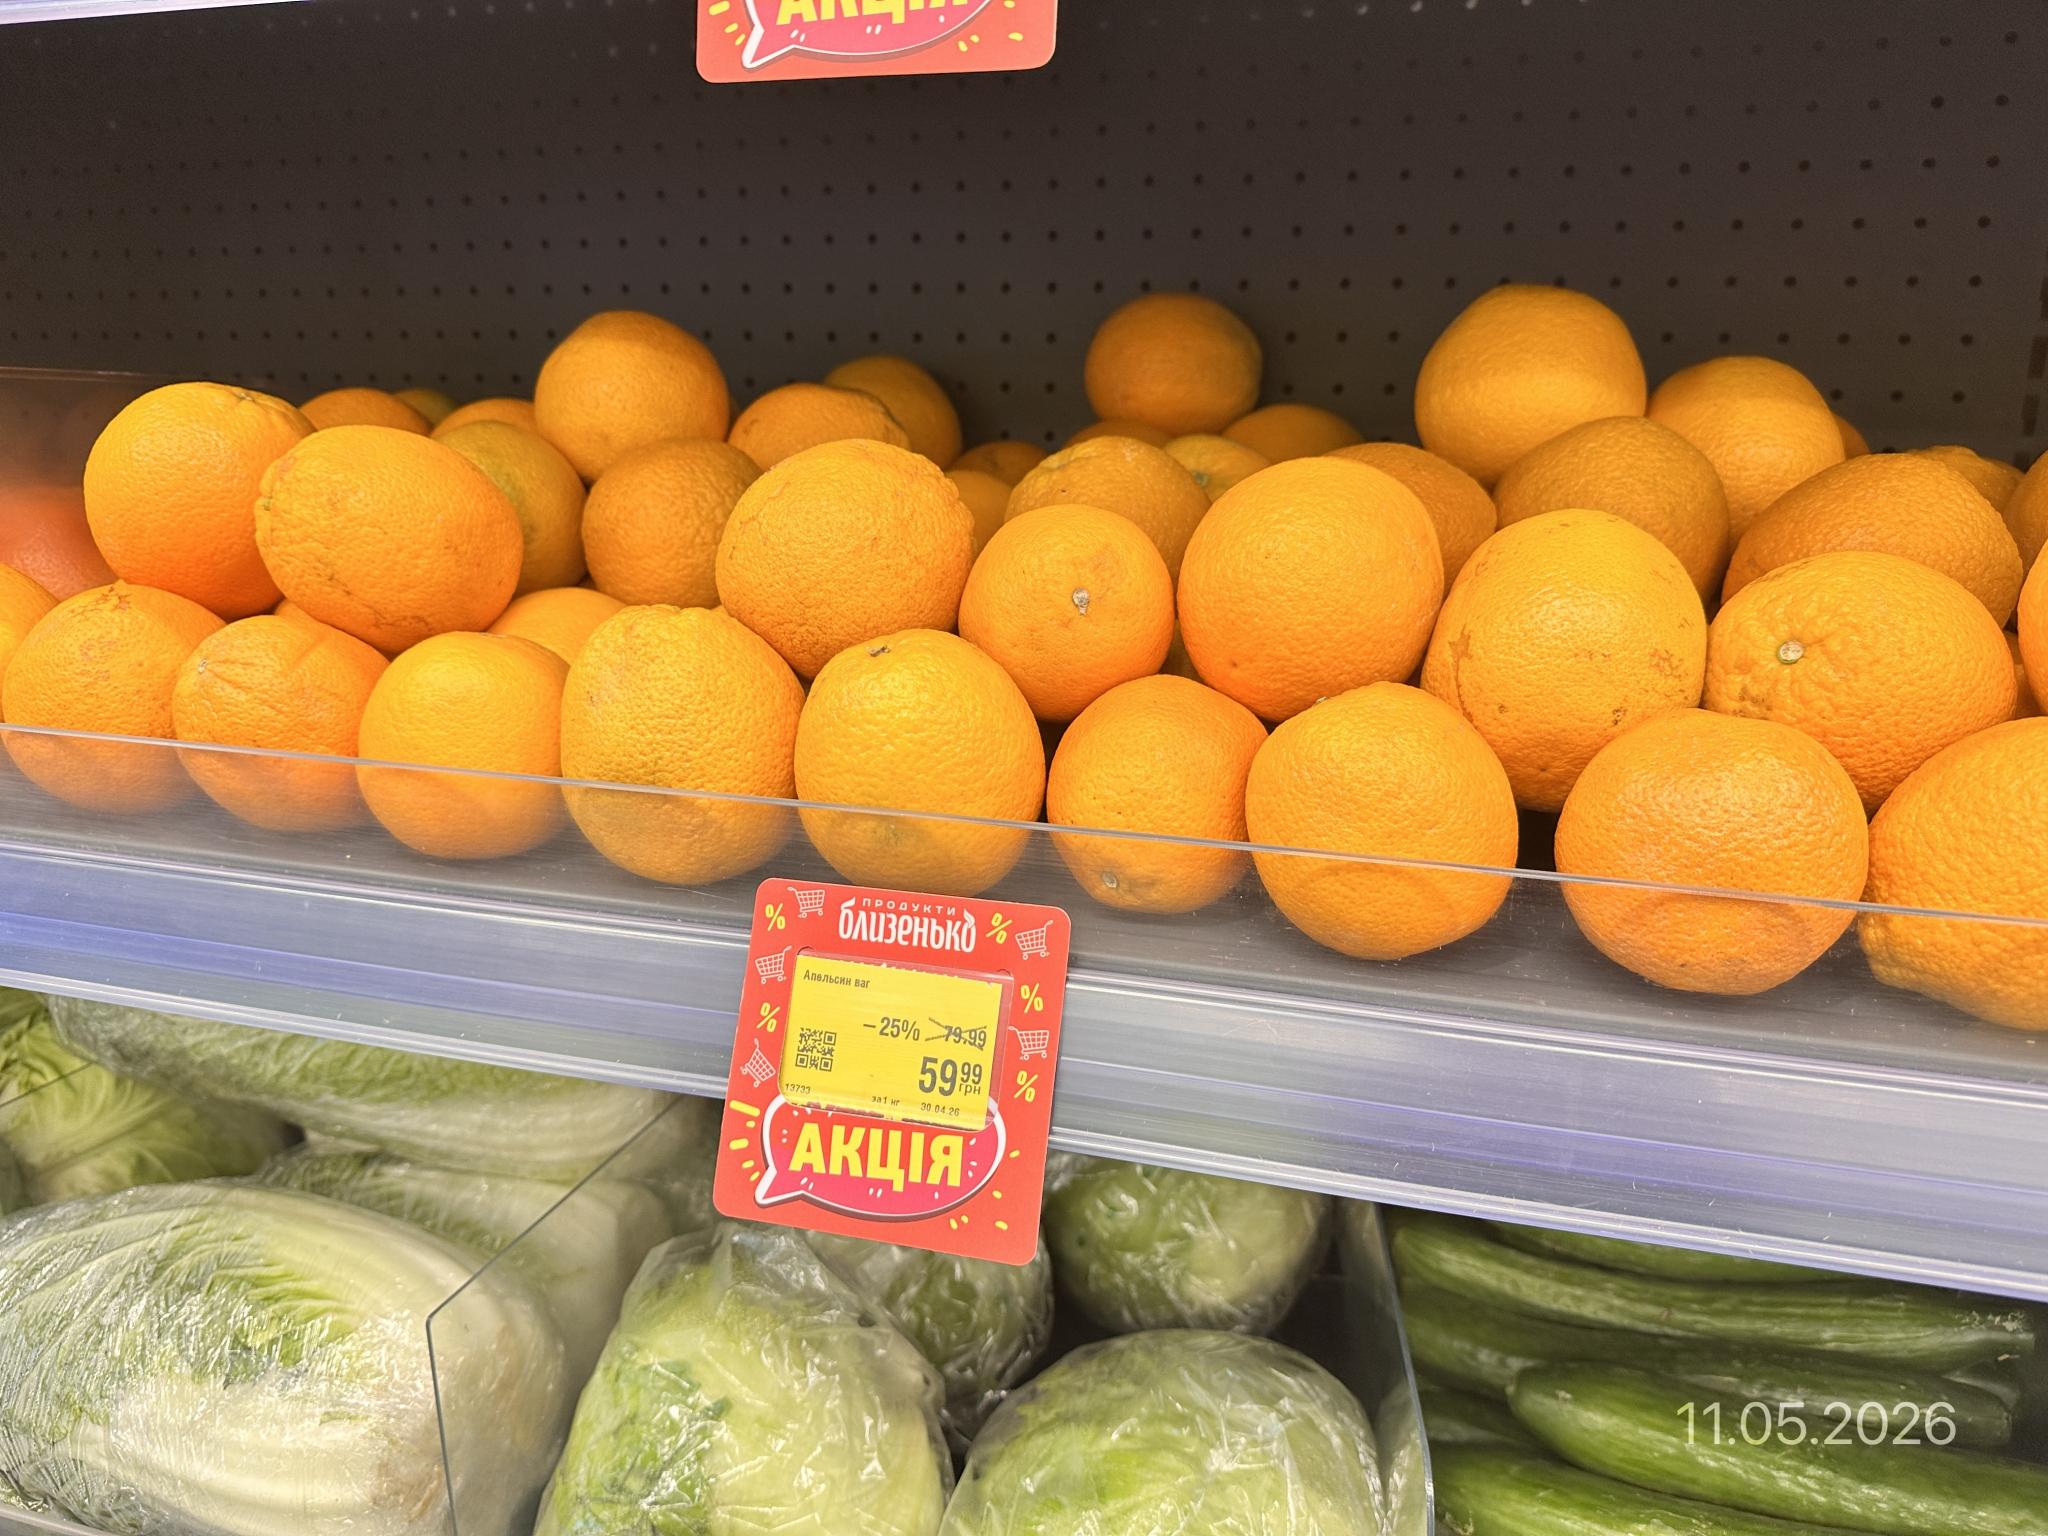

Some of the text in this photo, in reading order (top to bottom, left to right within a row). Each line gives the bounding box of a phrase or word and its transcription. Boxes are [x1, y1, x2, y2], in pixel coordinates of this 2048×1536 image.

[862, 898, 956, 916] ПРОДУКТИ
[803, 969, 870, 989] Апельсин ваг
[785, 1083, 811, 1095] 13733
[959, 1082, 981, 1096] грн
[788, 1122, 964, 1192] АКЦІЯ
